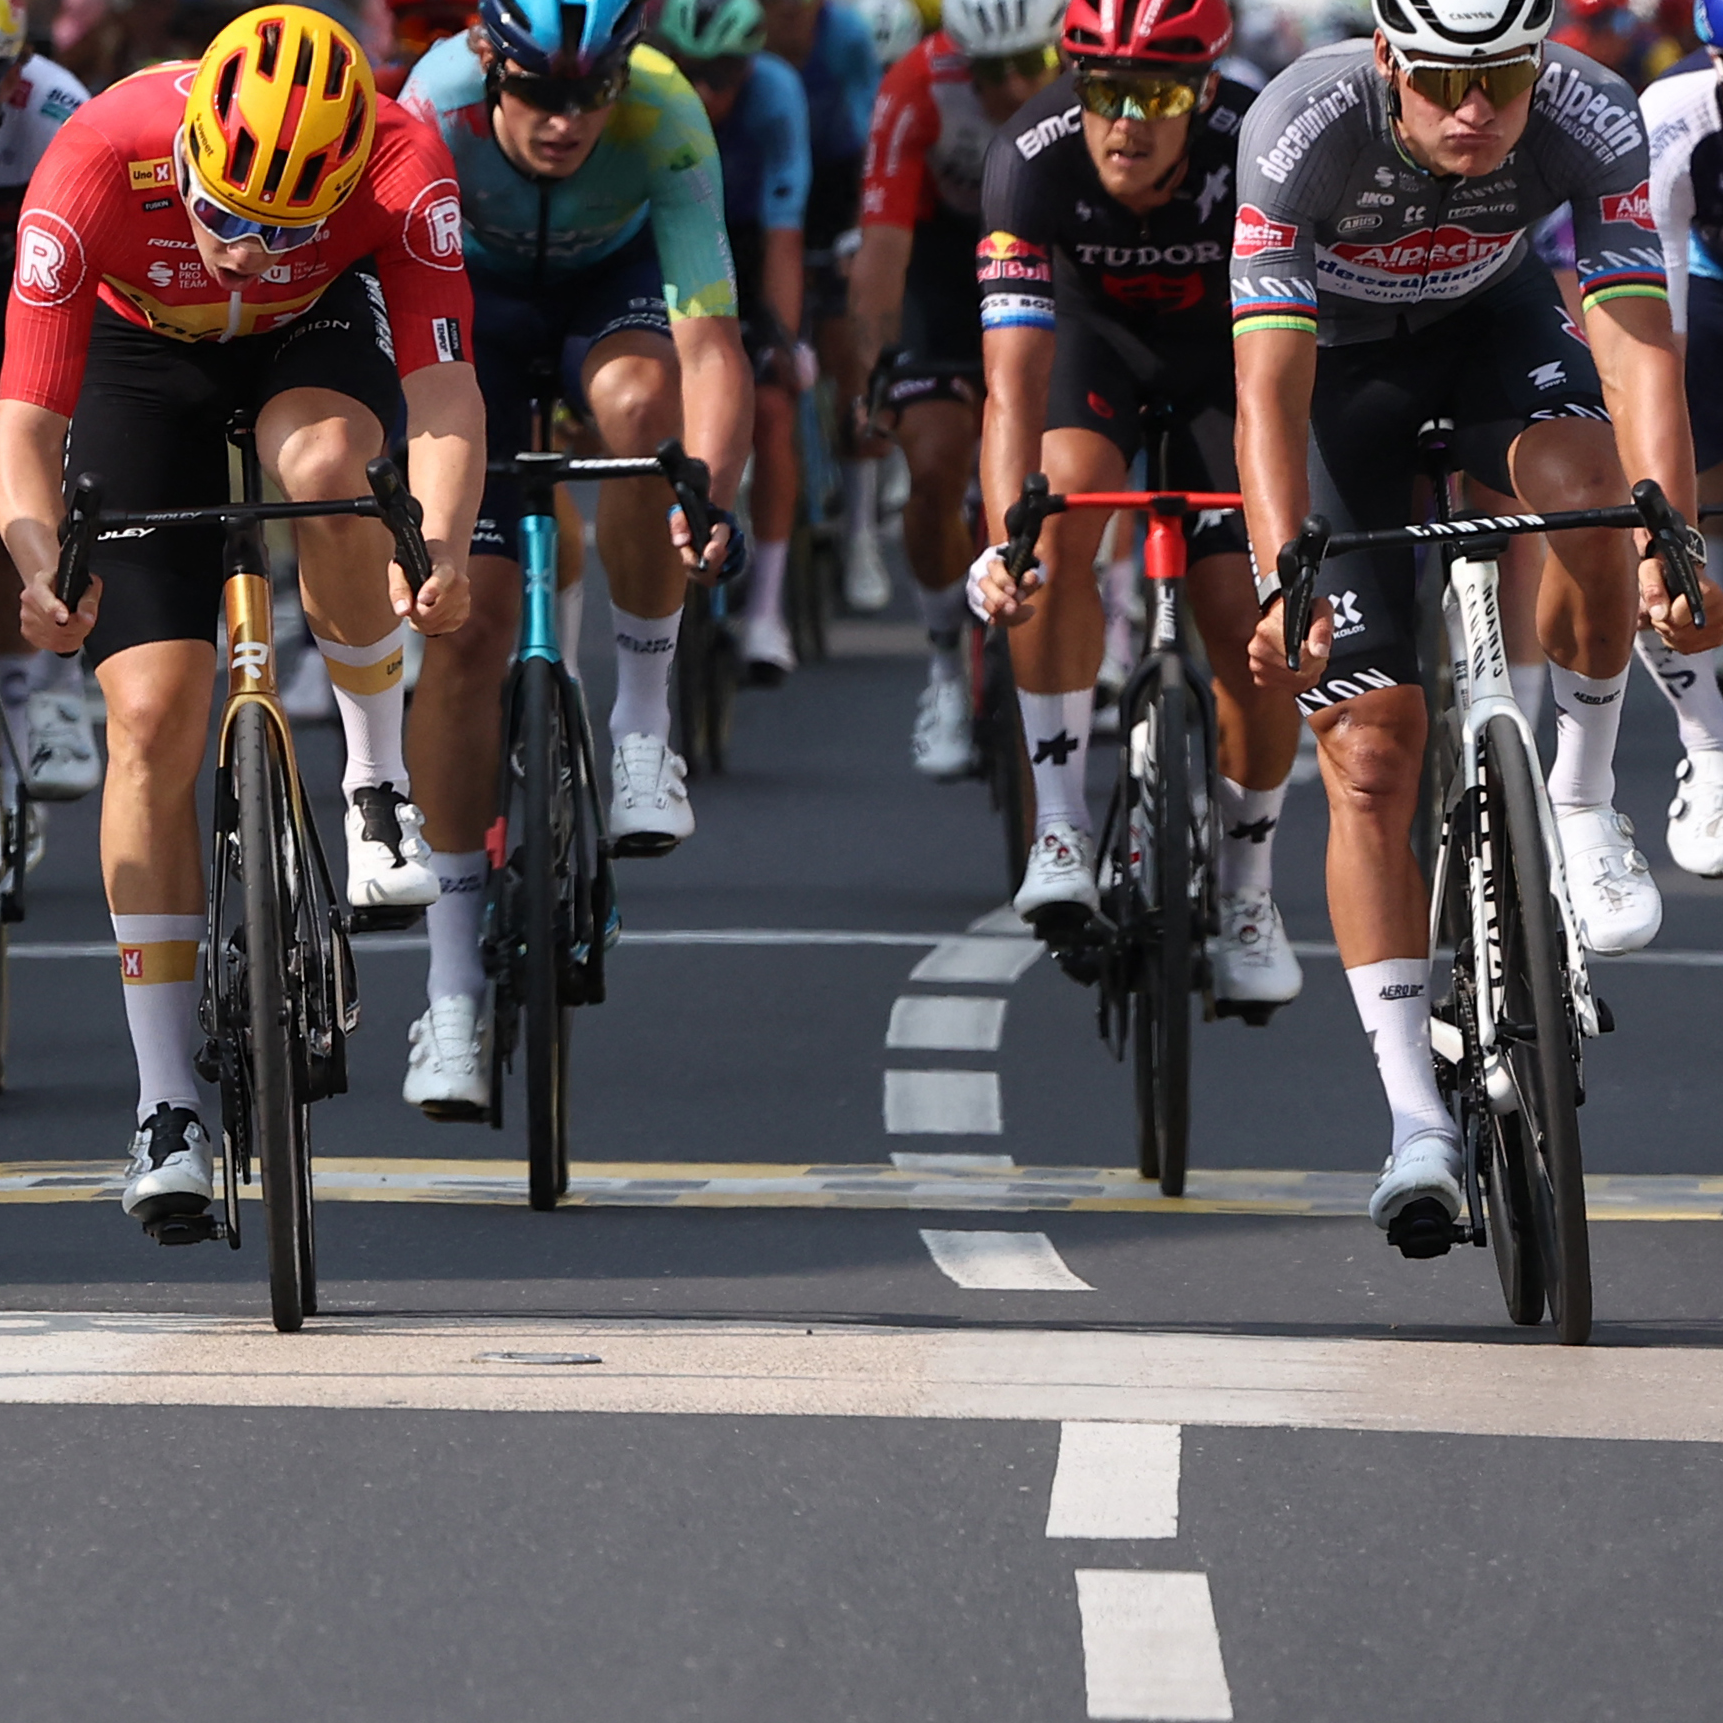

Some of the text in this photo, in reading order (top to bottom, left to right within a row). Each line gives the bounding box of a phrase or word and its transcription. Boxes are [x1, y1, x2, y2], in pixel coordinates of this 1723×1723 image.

[1535, 61, 1644, 158] Alpecin
[1014, 104, 1083, 162] BMC
[1256, 79, 1360, 184] deceuninck
[133, 163, 170, 182] Uno X
[144, 199, 170, 211] FUSION
[1616, 196, 1652, 219] Alp
[146, 237, 200, 250] RIDL
[1075, 240, 1224, 267] TUDOR
[1353, 238, 1502, 267] Alpecin
[21, 225, 66, 294] R
[178, 261, 202, 271] UCI
[178, 270, 201, 280] PRO
[1002, 260, 1052, 283] Bull
[178, 279, 208, 290] TEAM
[145, 510, 203, 523] RIDLEY
[1405, 513, 1546, 537] CANYON
[1157, 585, 1177, 643] BMC
[1482, 583, 1504, 679] CANYON
